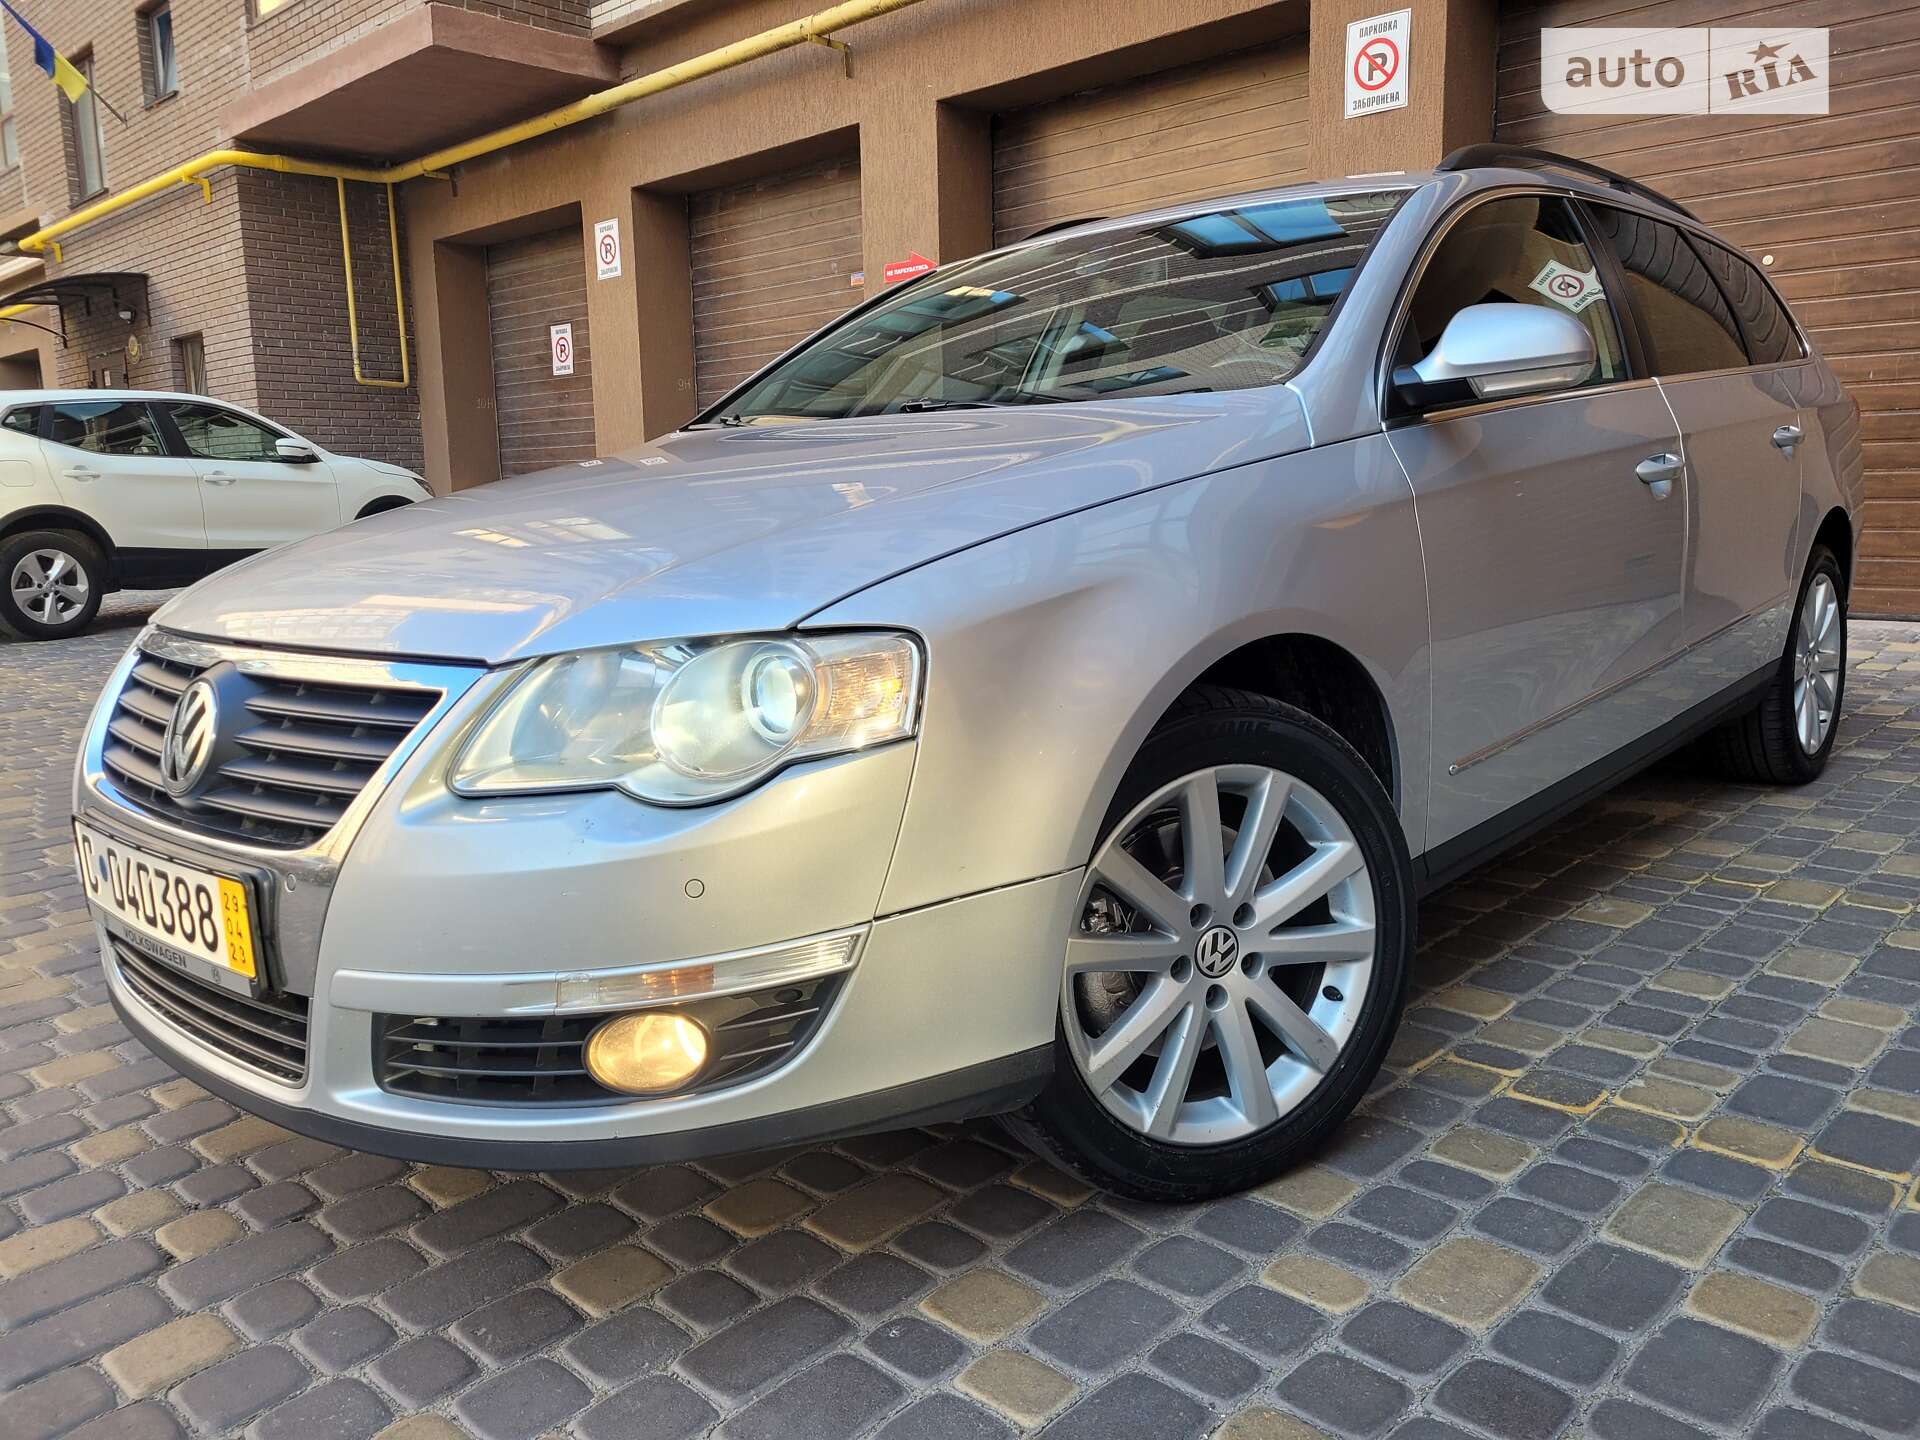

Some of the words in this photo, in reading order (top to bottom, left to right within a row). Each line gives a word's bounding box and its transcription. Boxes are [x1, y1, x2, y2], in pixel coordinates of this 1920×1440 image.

[1359, 19, 1398, 38] ПАРКОВКА
[1352, 91, 1400, 111] ЗАБОРОНЕНА
[106, 847, 219, 953] 040388
[222, 892, 240, 913] 29
[226, 918, 243, 938] 04
[123, 926, 188, 970] VOLKSWAGEN
[230, 942, 247, 964] 23
